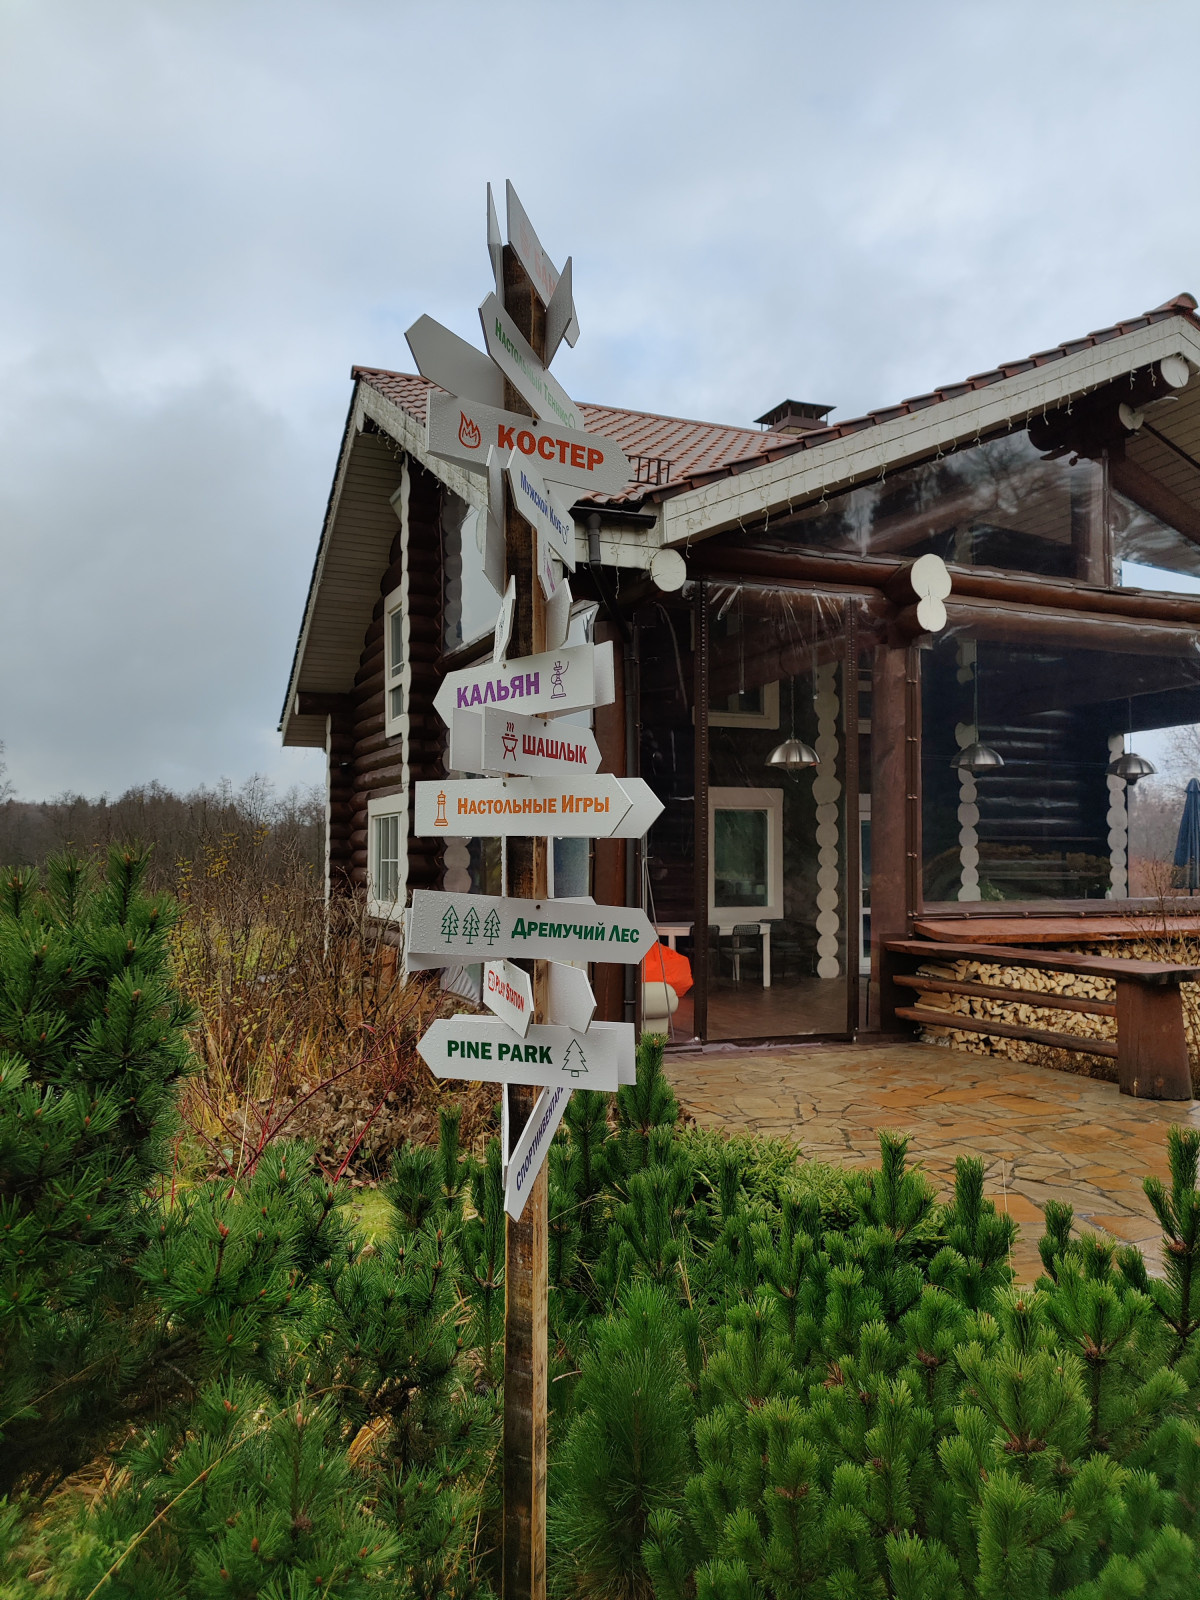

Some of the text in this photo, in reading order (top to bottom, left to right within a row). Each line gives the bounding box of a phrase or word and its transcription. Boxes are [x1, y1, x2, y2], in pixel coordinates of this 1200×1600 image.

[535, 250, 556, 298] БАН
[544, 382, 568, 426] ТЕННИС
[498, 424, 604, 471] КОСТЕР
[521, 470, 549, 518] МУЖСКОЙ
[549, 506, 562, 535] КЛУБ
[457, 672, 540, 708] КАЛЬЯН
[522, 734, 587, 764] ШАШЛЫК
[457, 794, 610, 815] НАСТОЛЬНЫЕ ИГРЫ
[511, 917, 640, 944] ДРЕМУЧИЙ ЛЕС
[495, 974, 525, 1013] PLAY STATION
[447, 1040, 553, 1064] PINE PARK
